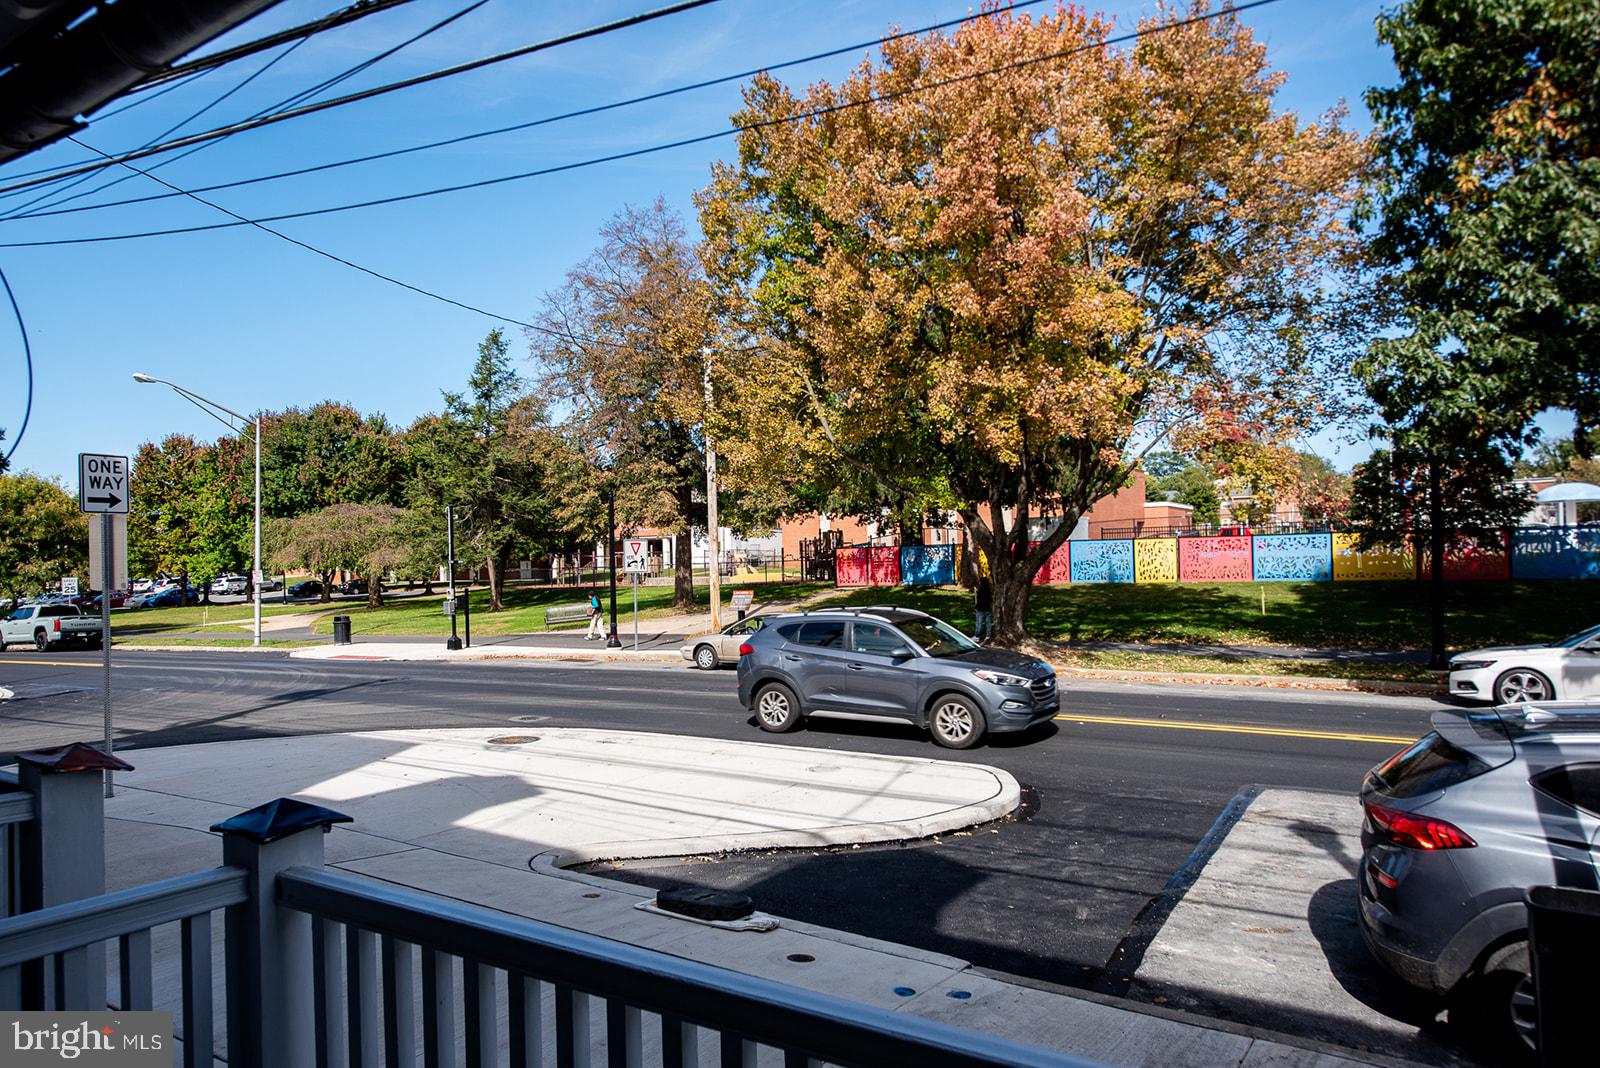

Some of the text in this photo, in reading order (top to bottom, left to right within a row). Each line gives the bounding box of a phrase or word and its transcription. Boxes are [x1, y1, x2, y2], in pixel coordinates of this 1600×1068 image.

[88, 459, 122, 474] ONE
[89, 475, 124, 490] WAY
[64, 585, 77, 593] 25
